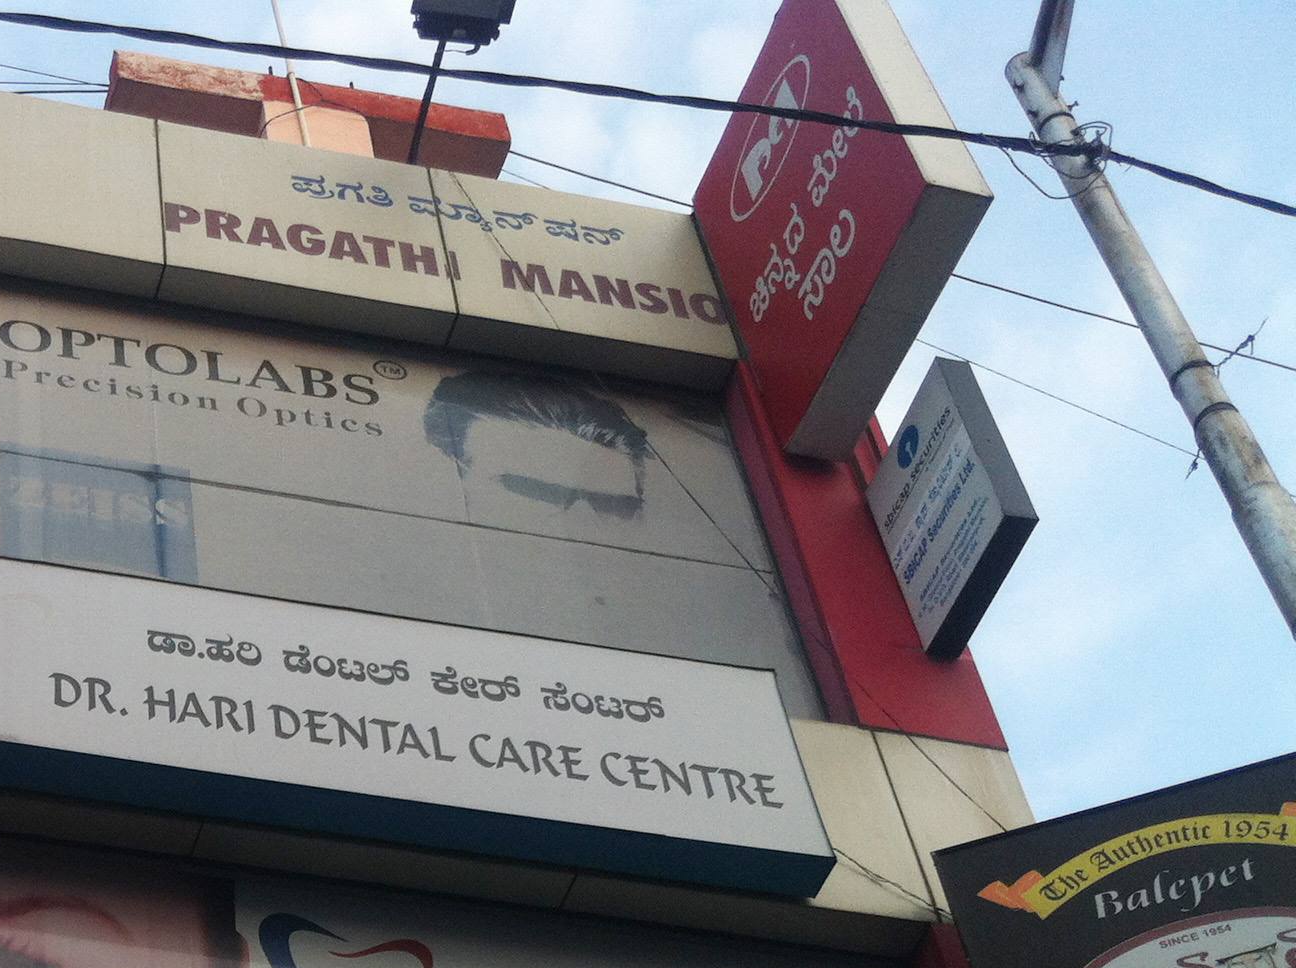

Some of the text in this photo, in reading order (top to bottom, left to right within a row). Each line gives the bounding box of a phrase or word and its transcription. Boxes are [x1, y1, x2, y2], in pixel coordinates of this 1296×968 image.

[163, 201, 461, 281] PRAGATHI
[3, 359, 384, 437] Precision Optics
[49, 672, 785, 810] DR. HARI DENTAL CARE CENTRE
[1039, 819, 1290, 903] The Authentic 1954
[1094, 857, 1258, 920] Balepet
[1158, 923, 1233, 950] SINCE 1954
